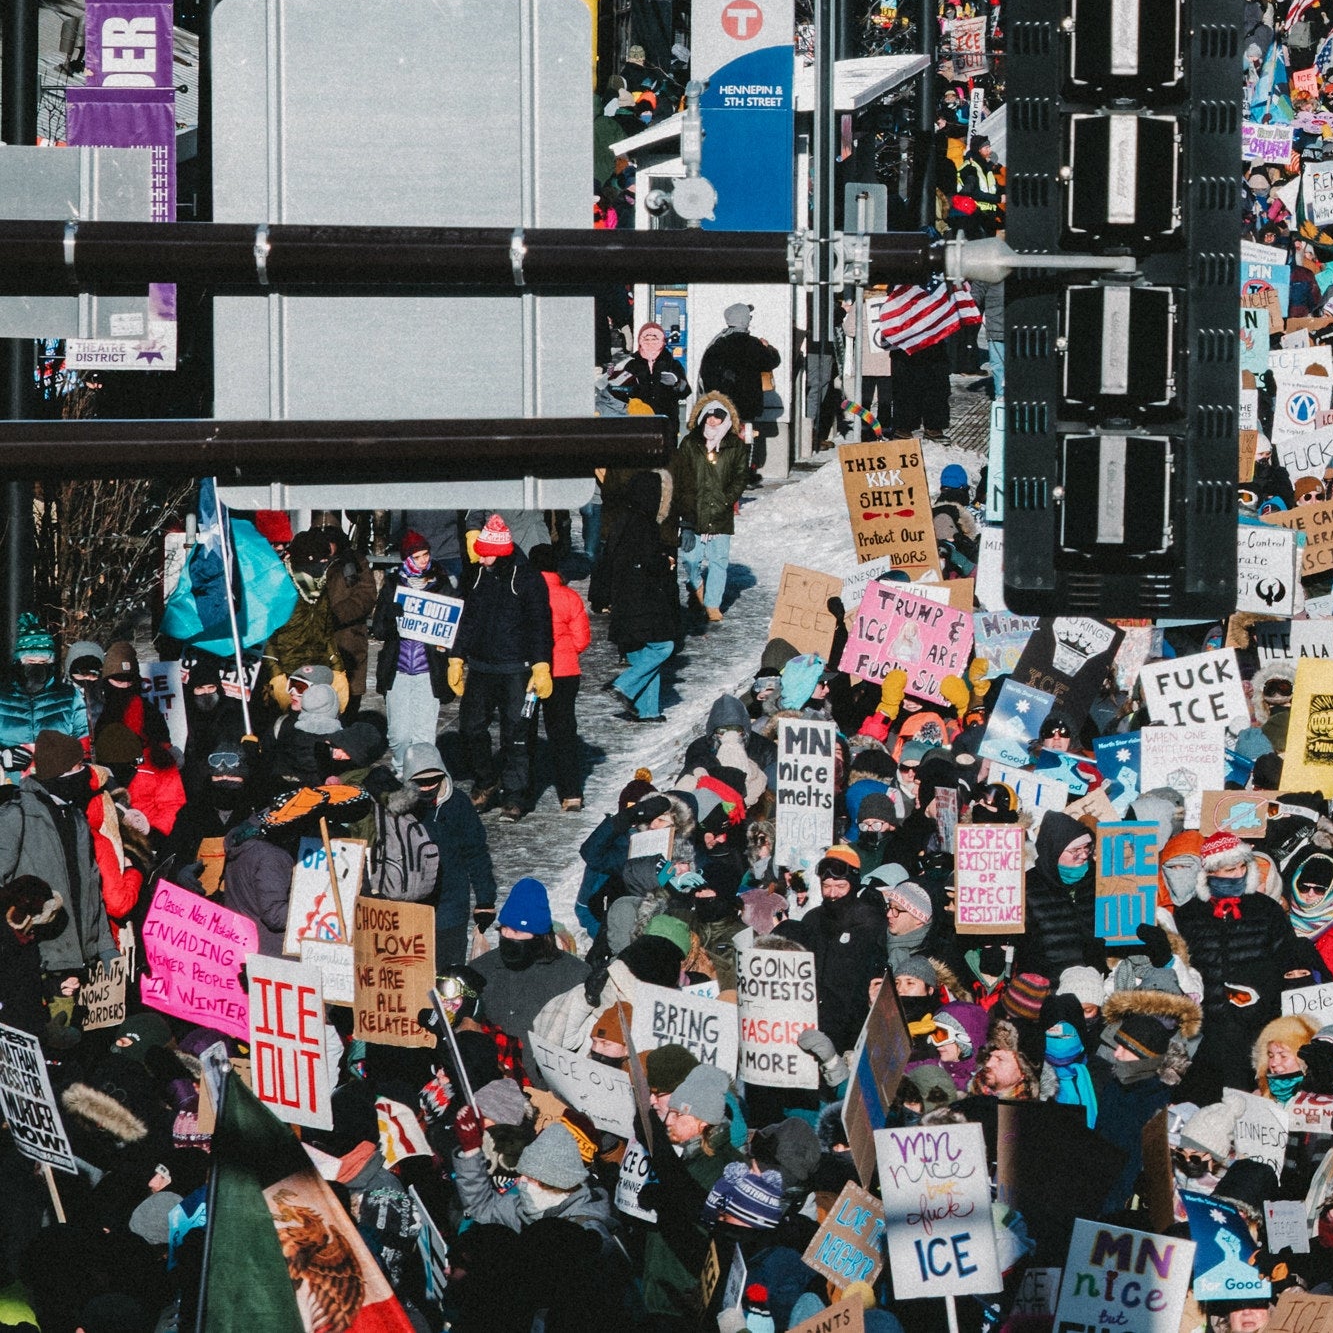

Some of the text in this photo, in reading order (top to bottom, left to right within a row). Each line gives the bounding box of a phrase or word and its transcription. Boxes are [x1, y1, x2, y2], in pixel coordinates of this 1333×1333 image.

[719, 84, 783, 96] HENNEPIN &
[724, 96, 784, 107] 5TH STREET
[75, 352, 126, 363] DISTRICT
[845, 453, 919, 473] THIS IS
[866, 470, 906, 487] KKK
[859, 487, 915, 508] SHIT!
[857, 527, 926, 548] Protect Our
[404, 597, 451, 623] ICE OUT!
[1300, 643, 1308, 658] A
[1309, 642, 1330, 658] LA
[1156, 658, 1235, 690] FUCK
[1168, 692, 1230, 726] ICE
[785, 725, 832, 758] MN
[778, 759, 828, 784] nice
[778, 784, 832, 809] melts
[355, 903, 400, 930] CHOOSE
[375, 932, 425, 957] LOVE
[357, 968, 405, 991] WE ARE
[253, 976, 320, 1046] ICE
[376, 994, 407, 1012] ALL
[256, 1043, 321, 1115] OUT
